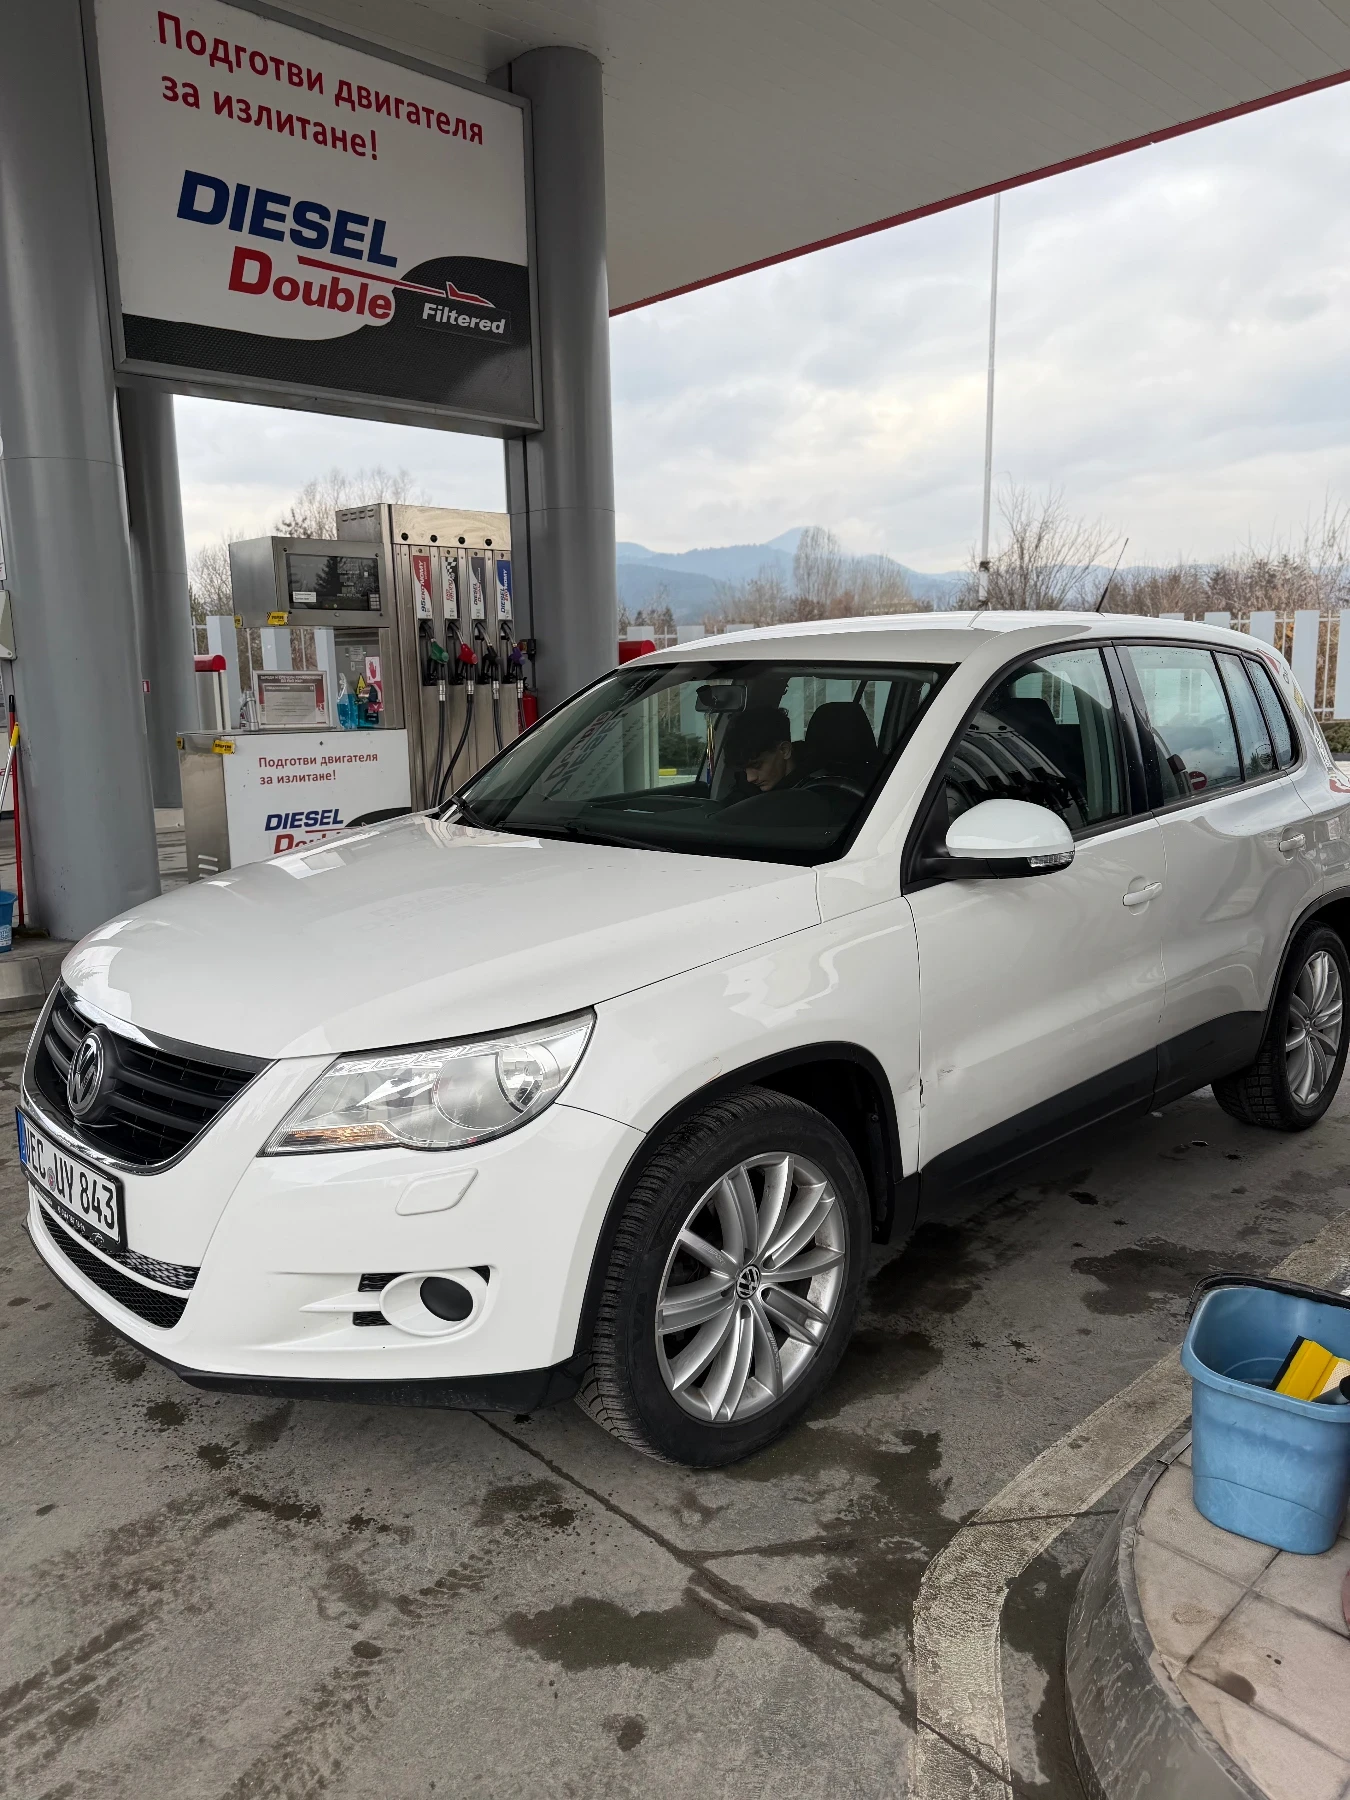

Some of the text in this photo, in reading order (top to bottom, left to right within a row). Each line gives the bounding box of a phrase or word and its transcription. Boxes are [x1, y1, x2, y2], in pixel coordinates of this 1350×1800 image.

[157, 10, 484, 145] Подготви двигателя
[161, 74, 379, 161] за излитане!
[176, 169, 398, 268] DIESEL
[228, 245, 392, 320] Double
[422, 302, 506, 334] Filtered
[258, 753, 378, 769] Подготви двигателя
[260, 769, 336, 785] за излитане!
[264, 808, 344, 832] DIESEL
[54, 1152, 74, 1204] UY
[80, 1171, 115, 1230] 843
